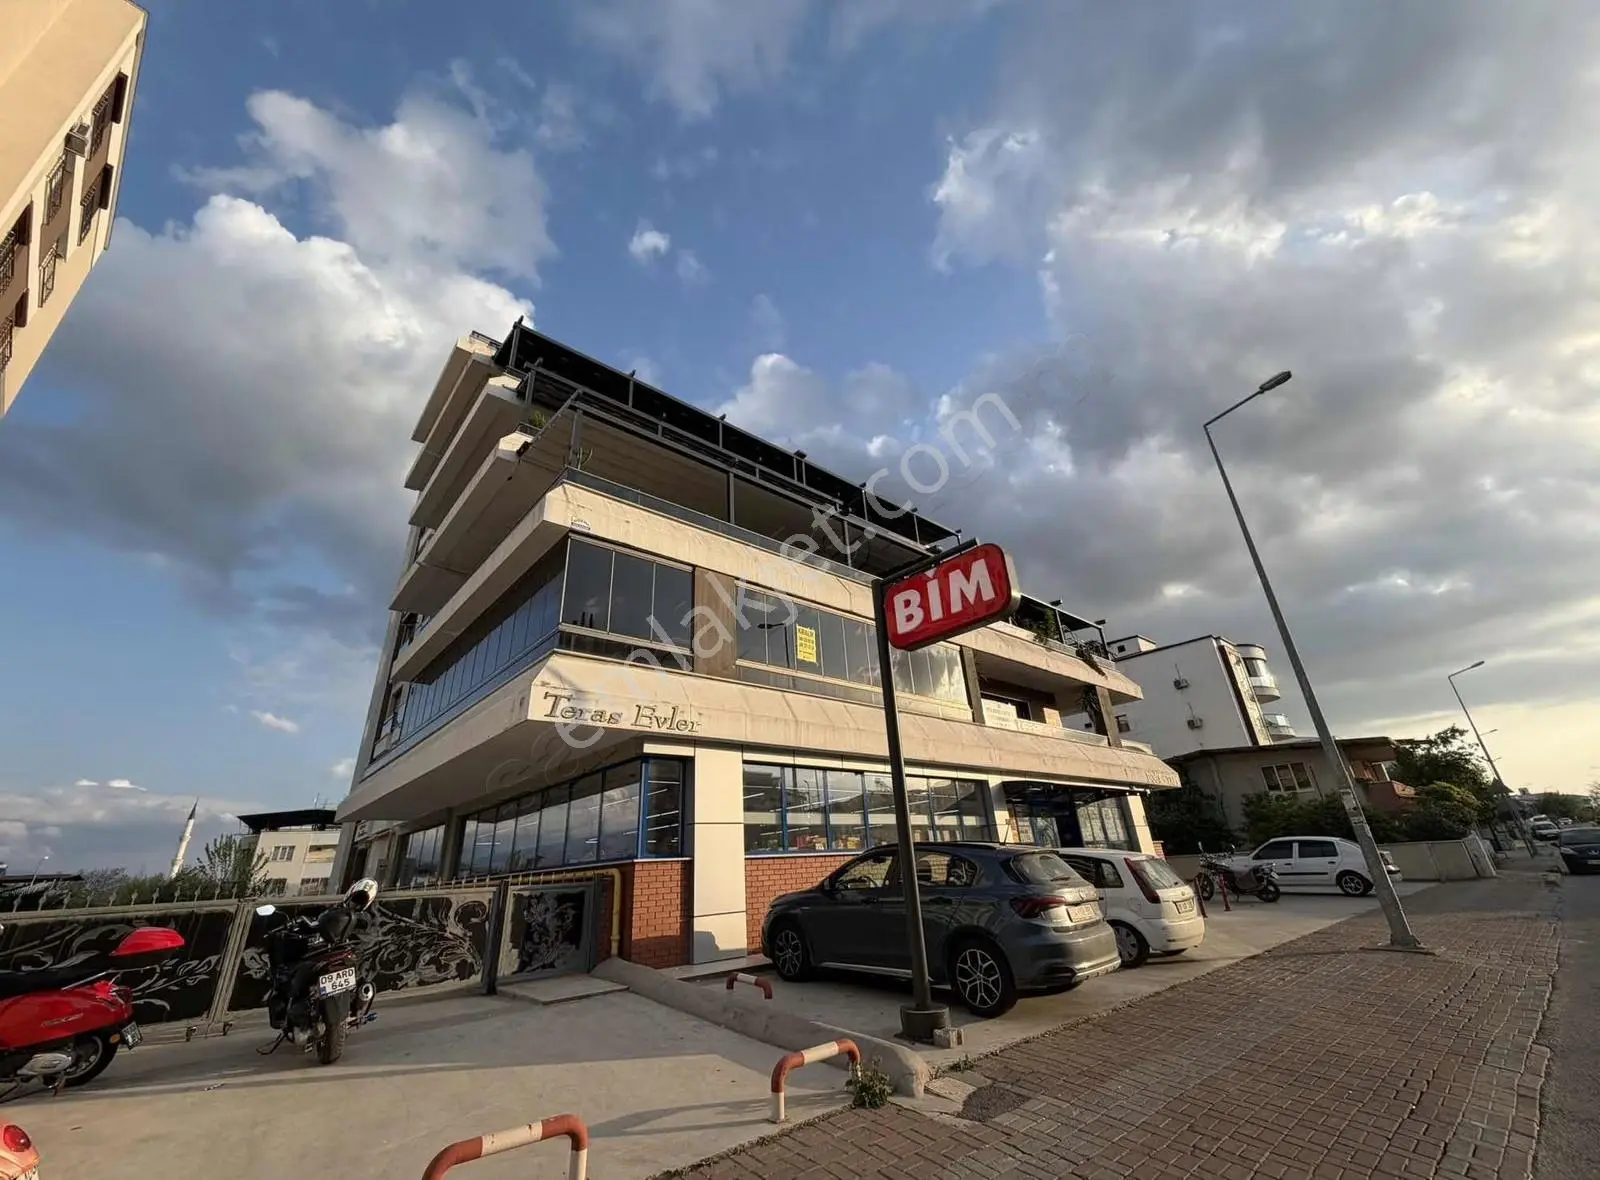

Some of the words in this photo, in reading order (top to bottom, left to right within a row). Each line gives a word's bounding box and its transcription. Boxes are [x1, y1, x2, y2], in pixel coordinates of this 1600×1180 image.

[893, 559, 995, 634] BİM
[543, 691, 623, 725] Teras
[630, 704, 702, 733] Evler
[320, 975, 333, 985] 09
[336, 968, 354, 980] ARD
[331, 978, 350, 990] 645
